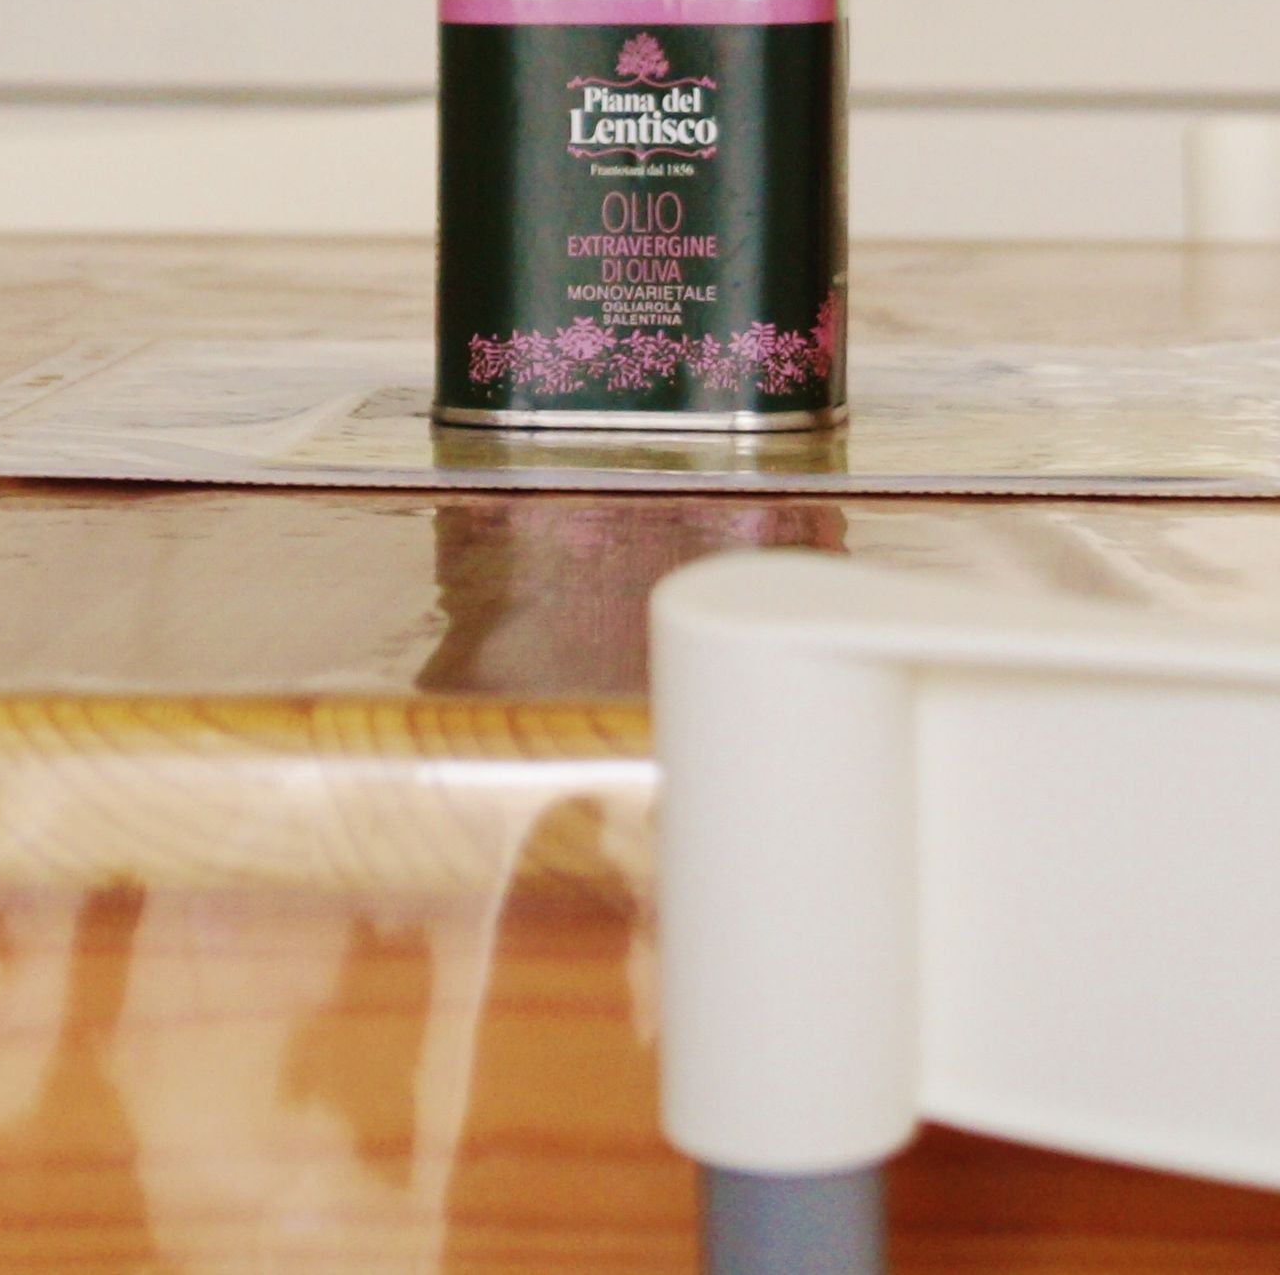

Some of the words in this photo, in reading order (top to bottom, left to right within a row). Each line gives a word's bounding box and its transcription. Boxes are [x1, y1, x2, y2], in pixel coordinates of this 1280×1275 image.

[584, 87, 655, 113] Piana
[662, 87, 701, 113] del
[570, 108, 718, 144] Lentisco
[667, 164, 694, 177] 1856
[602, 191, 682, 233] OLIO
[567, 236, 717, 257] EXTRAVERGINE
[603, 260, 621, 282] DI
[626, 260, 682, 282] OLIVA
[568, 285, 717, 301] MONOVARIETALE
[602, 302, 682, 314] OGLIAROLA
[602, 314, 682, 325] SALENTINA
